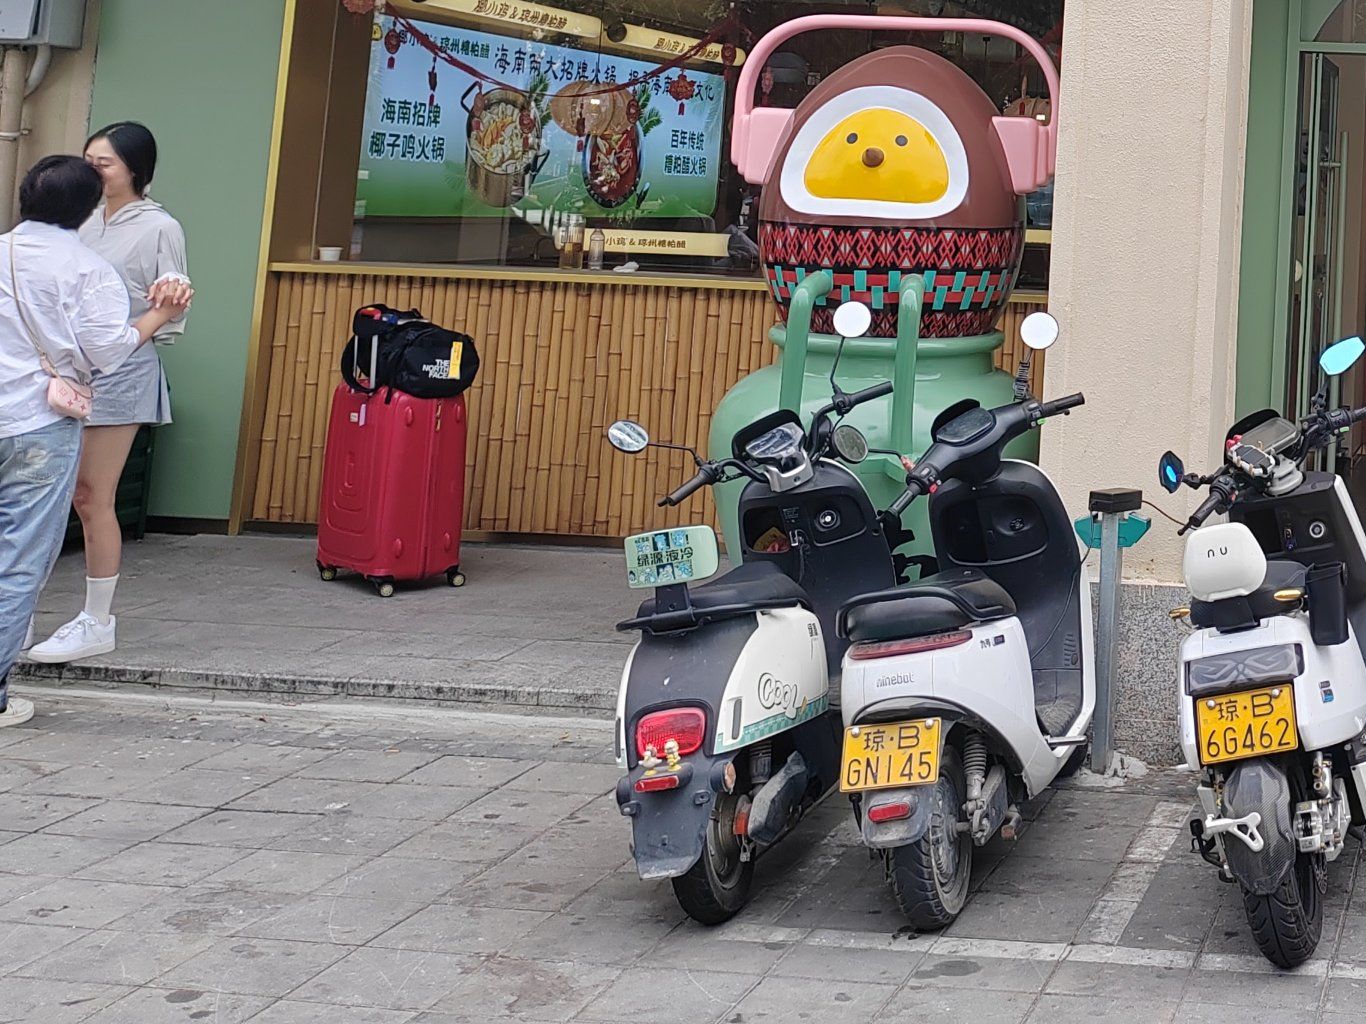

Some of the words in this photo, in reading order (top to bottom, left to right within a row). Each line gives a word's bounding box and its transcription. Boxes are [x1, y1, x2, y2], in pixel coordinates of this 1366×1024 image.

[380, 97, 441, 128] 海南招牌
[368, 130, 445, 162] 椰子鸡火锅
[670, 128, 705, 151] 百年传统
[637, 546, 694, 567] 绿源液冷
[875, 672, 915, 688] ninebot
[1206, 717, 1291, 758] 6G462
[847, 750, 932, 787] GN145
